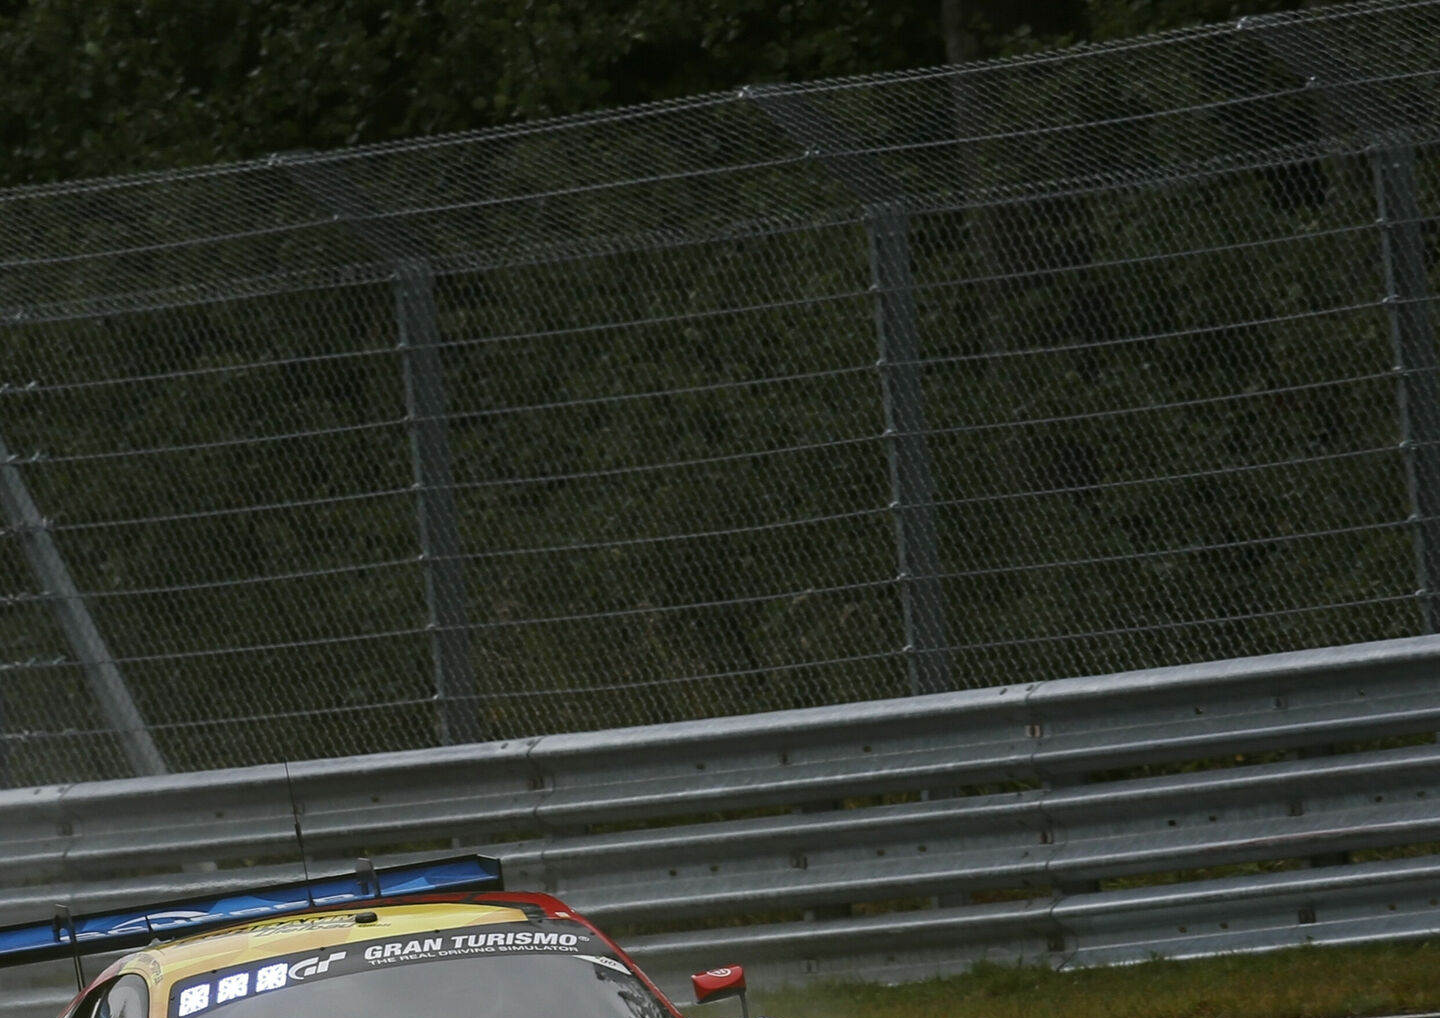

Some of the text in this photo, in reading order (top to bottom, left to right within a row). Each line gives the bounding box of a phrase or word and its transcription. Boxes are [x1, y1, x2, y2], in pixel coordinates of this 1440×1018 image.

[363, 938, 442, 960] GRAN
[451, 932, 578, 949] TURISMO
[368, 944, 579, 966] THE REAL DRIVING SIMULATOR
